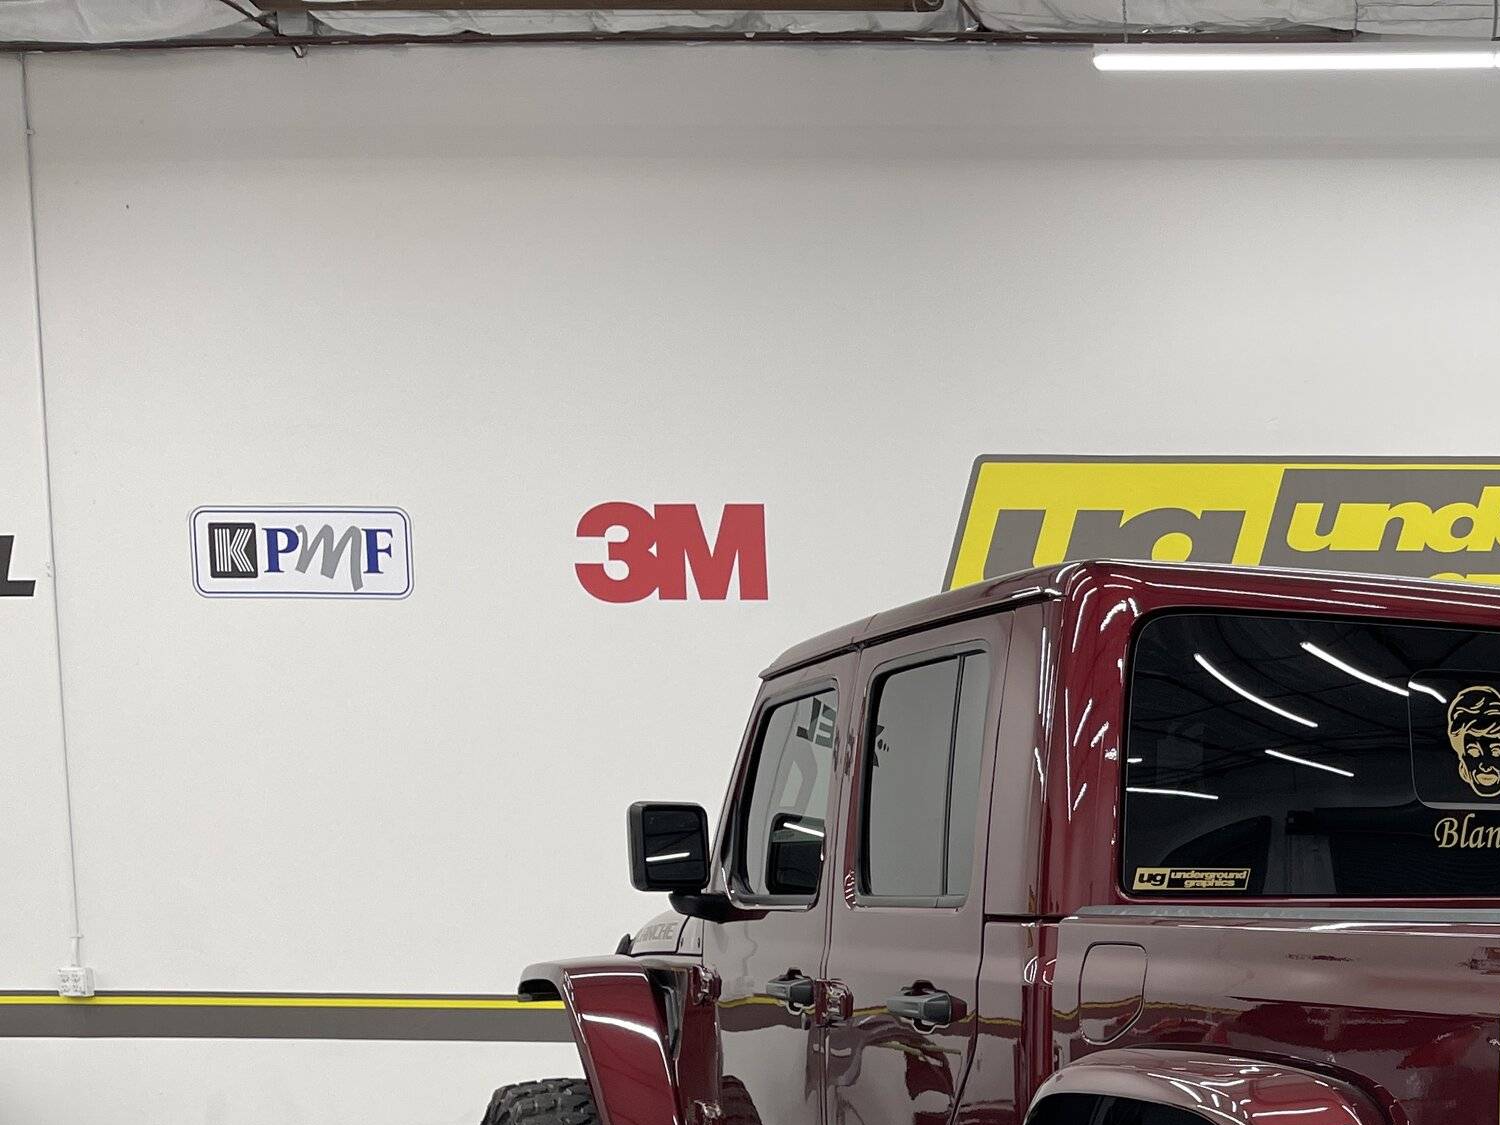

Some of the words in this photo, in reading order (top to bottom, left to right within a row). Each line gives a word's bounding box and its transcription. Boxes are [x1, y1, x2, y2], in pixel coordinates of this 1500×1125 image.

[208, 522, 394, 592] KPMF
[575, 502, 768, 603] 3M
[1139, 872, 1167, 886] ug
[1171, 871, 1247, 880] underground
[1184, 879, 1235, 888] graphics
